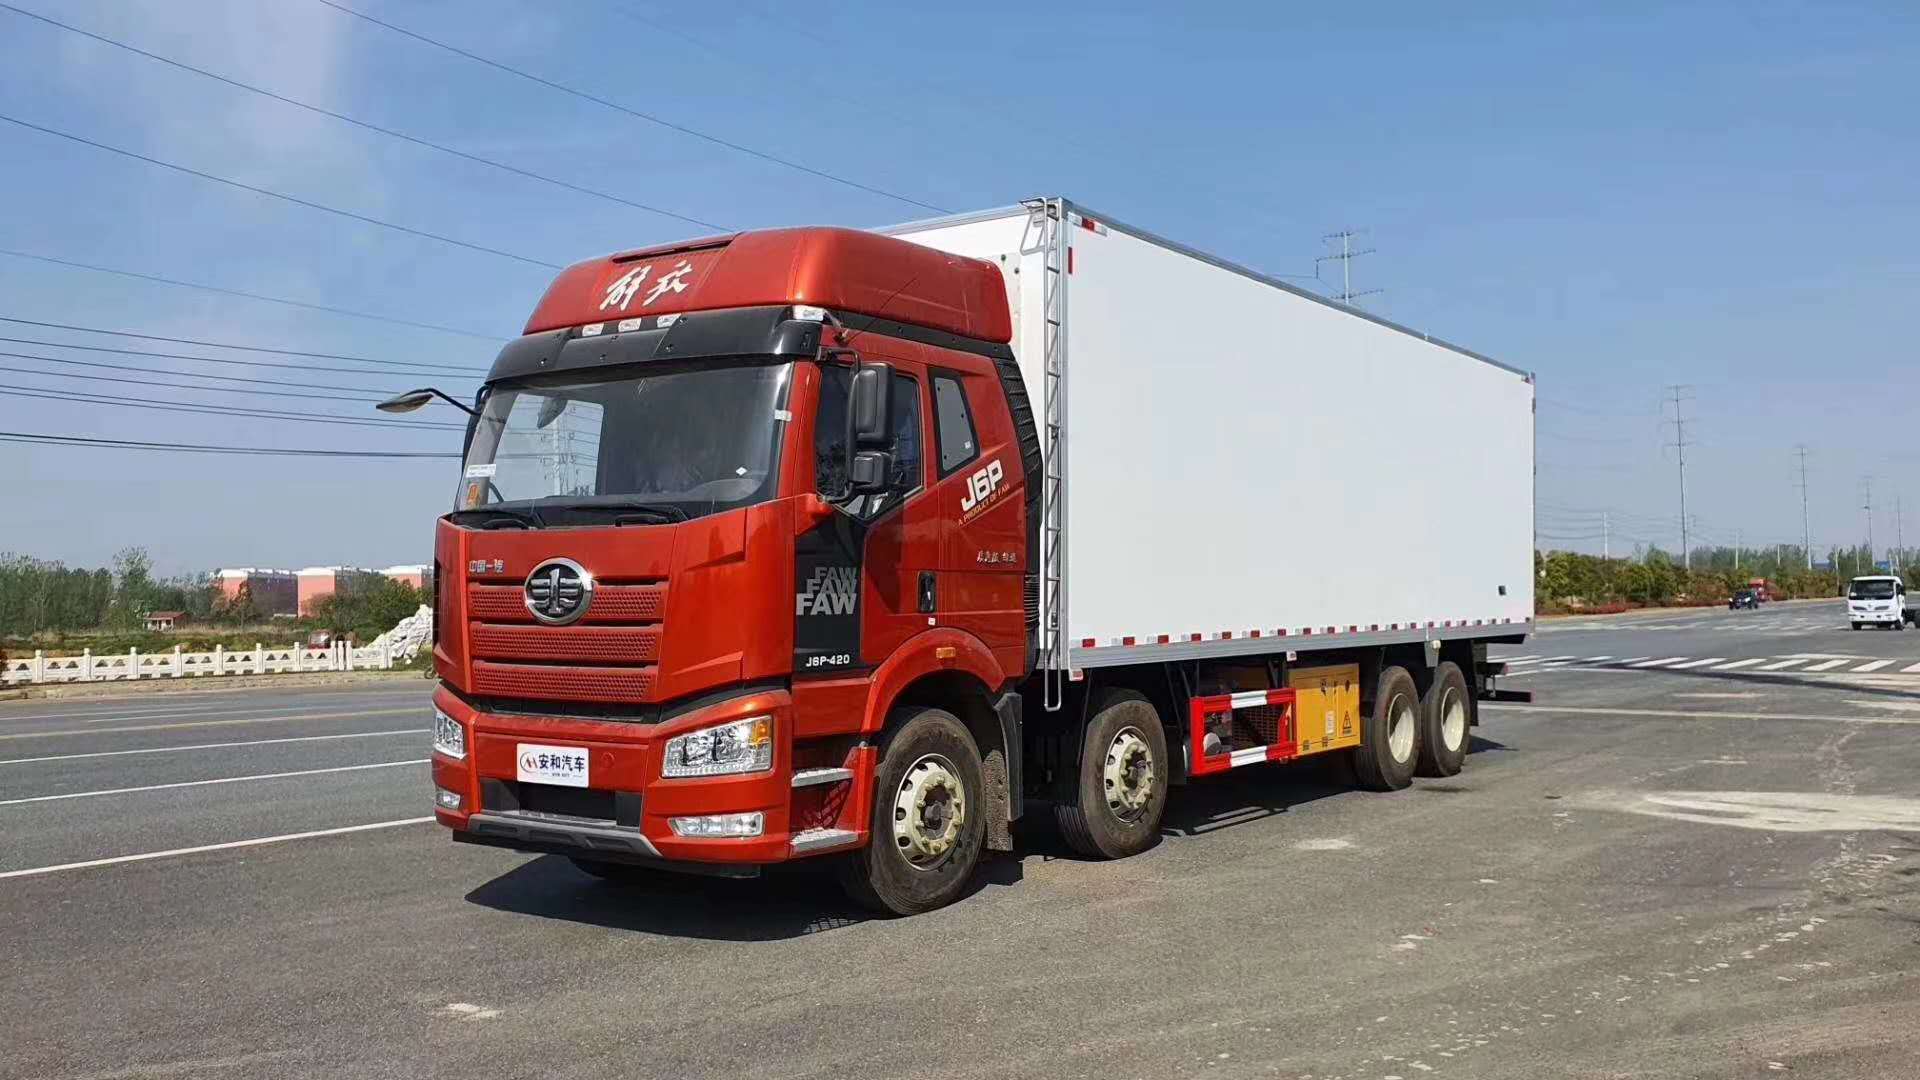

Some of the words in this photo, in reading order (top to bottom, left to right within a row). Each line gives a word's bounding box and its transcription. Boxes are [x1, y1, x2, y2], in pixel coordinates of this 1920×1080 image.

[599, 259, 693, 311] 解放
[960, 459, 1003, 511] J6P
[796, 592, 857, 616] FAW
[805, 654, 850, 668] J6P-420
[538, 753, 585, 772] 安和汽车
